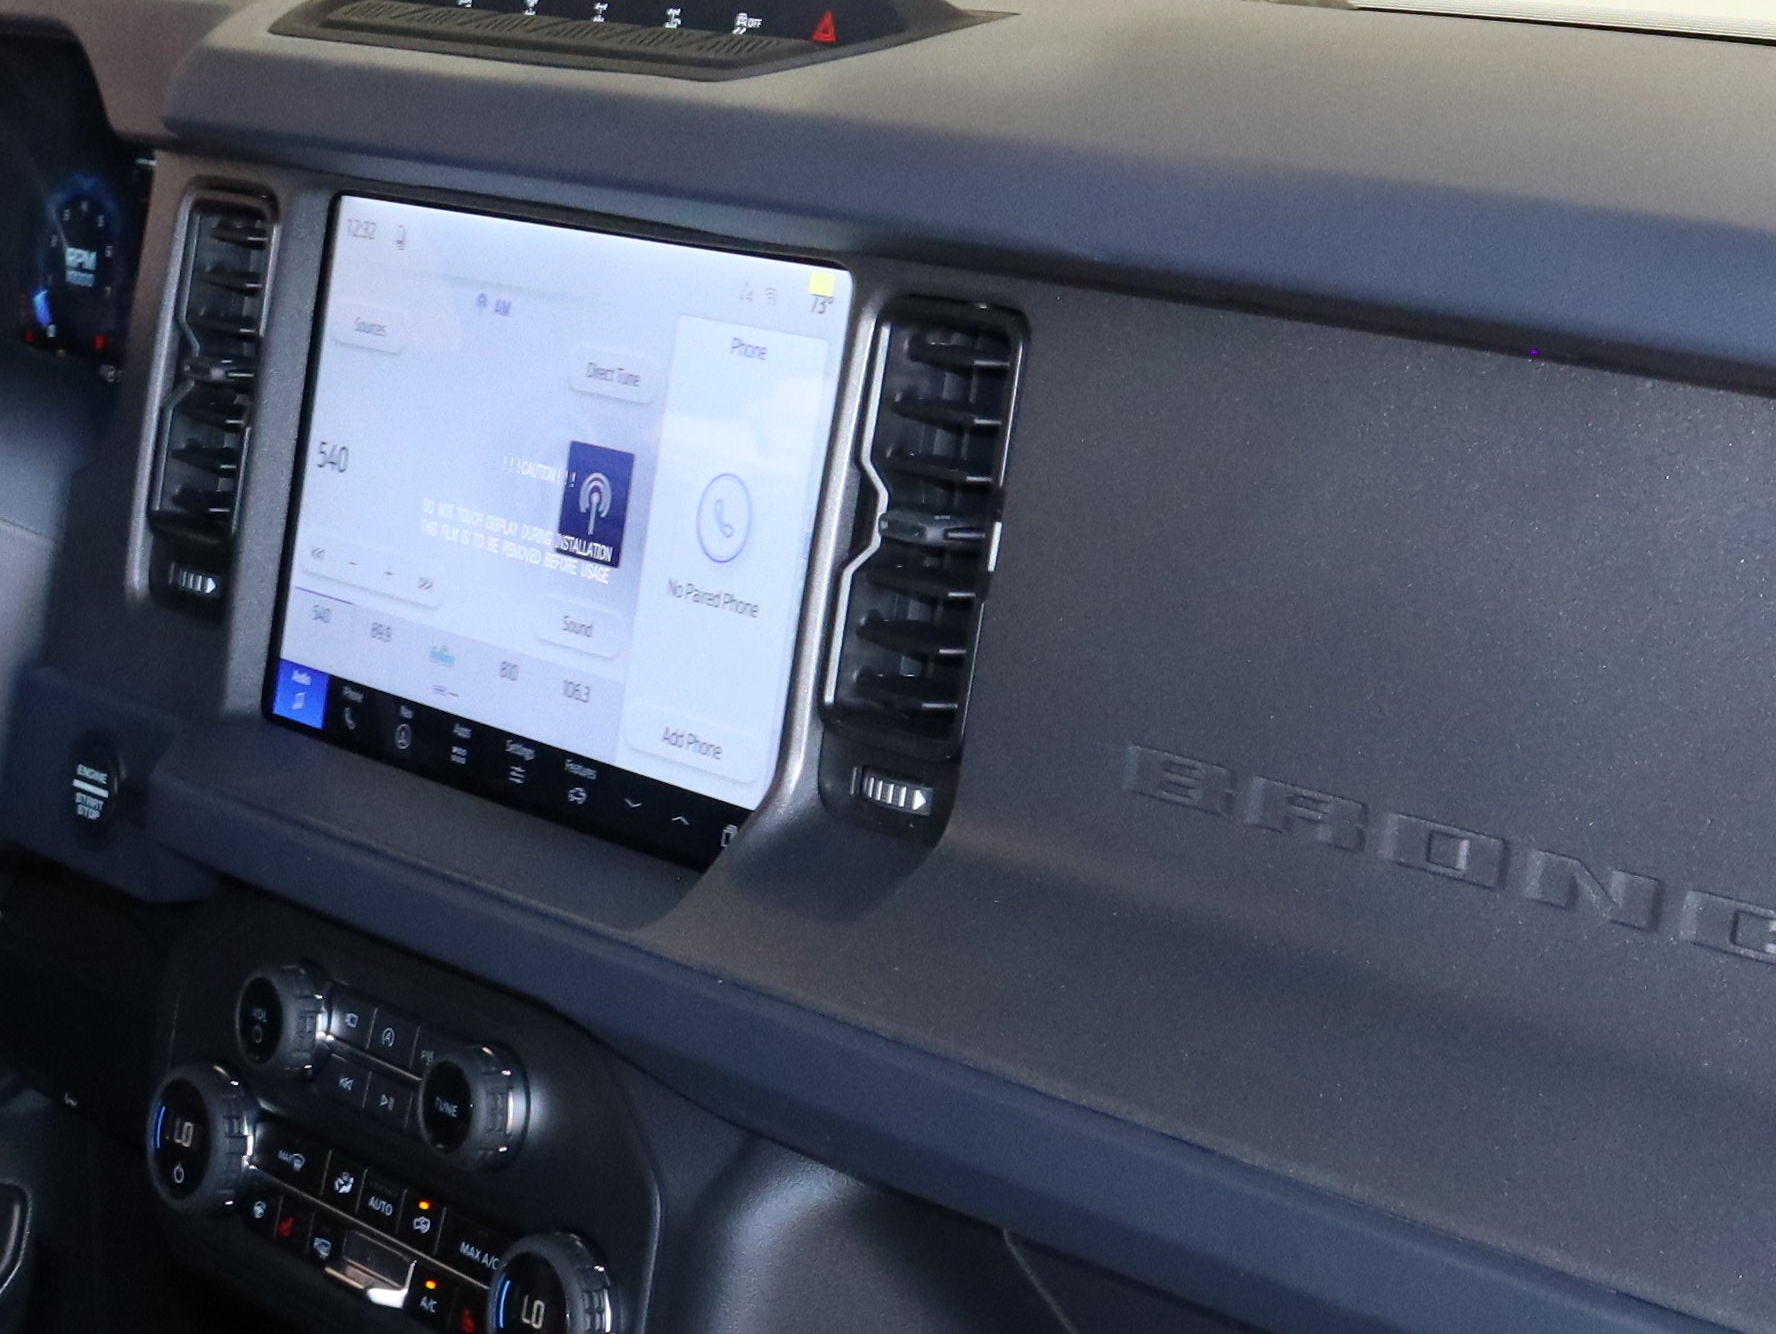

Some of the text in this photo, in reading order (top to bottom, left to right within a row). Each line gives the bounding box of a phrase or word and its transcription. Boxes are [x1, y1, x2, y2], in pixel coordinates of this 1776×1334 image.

[730, 337, 768, 360] Phone
[585, 362, 641, 387] Direct Tune
[317, 441, 349, 473] 540
[422, 498, 613, 562] DO NOT TOUCH DISPLAY DURING INSTALLATION
[422, 518, 612, 584] THIS FILM IS TO BE REMOVED BEFORE USAGE
[667, 578, 759, 618] No Paired Phone
[562, 615, 593, 638] Sound
[661, 725, 723, 760] Add Phone
[434, 1096, 459, 1118] TUNE
[368, 1195, 393, 1216] AUTO
[459, 1241, 501, 1271] MAX A/C
[420, 1296, 438, 1313] A/C
